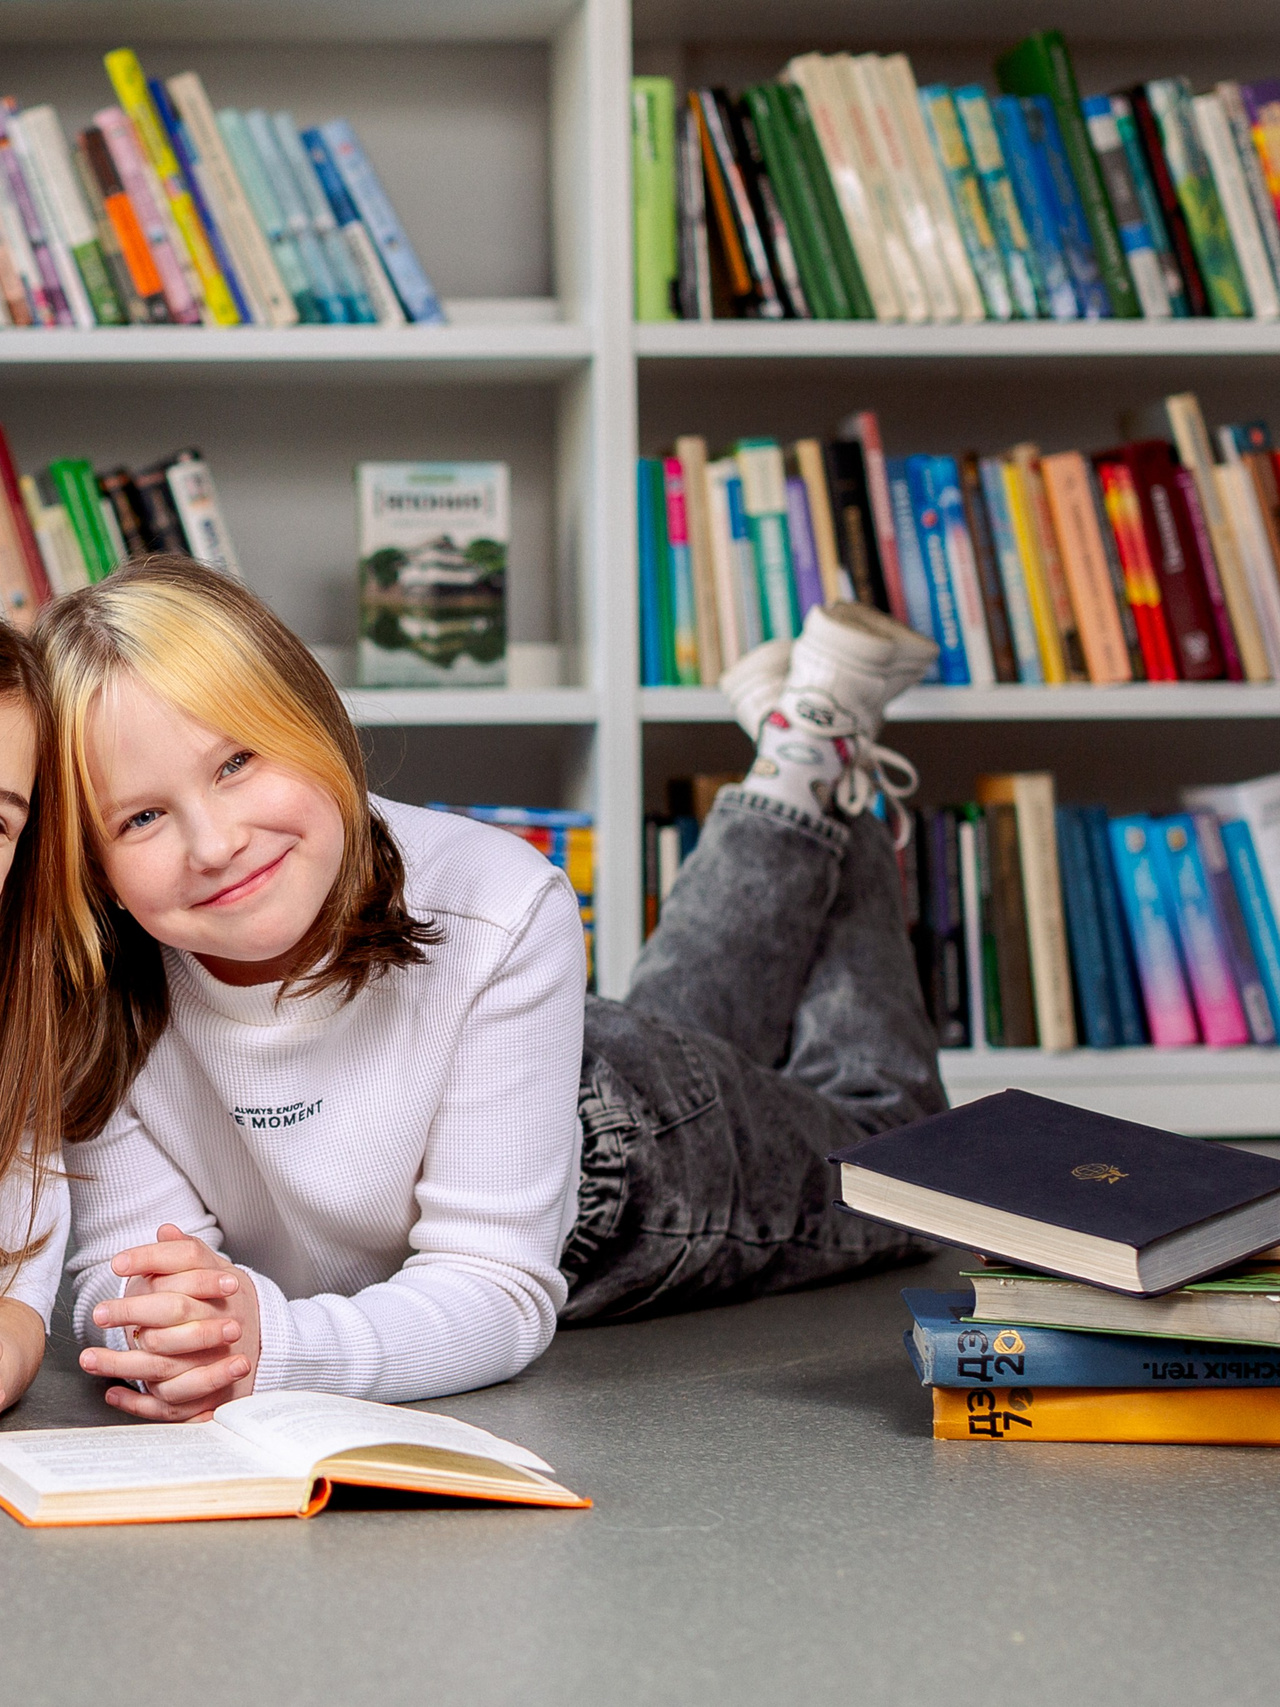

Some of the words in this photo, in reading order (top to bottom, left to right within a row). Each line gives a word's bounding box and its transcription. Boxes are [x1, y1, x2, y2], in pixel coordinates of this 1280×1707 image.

[229, 1112, 245, 1126] E
[251, 1098, 323, 1129] MOMENT
[234, 1106, 273, 1115] ALWAYS
[276, 1101, 305, 1115] ENJOY
[957, 1329, 994, 1382] ДЭ
[994, 1355, 1025, 1376] 2
[1143, 1362, 1198, 1380] тел.
[967, 1387, 1003, 1438] ДЭ
[1003, 1411, 1033, 1430] 7
